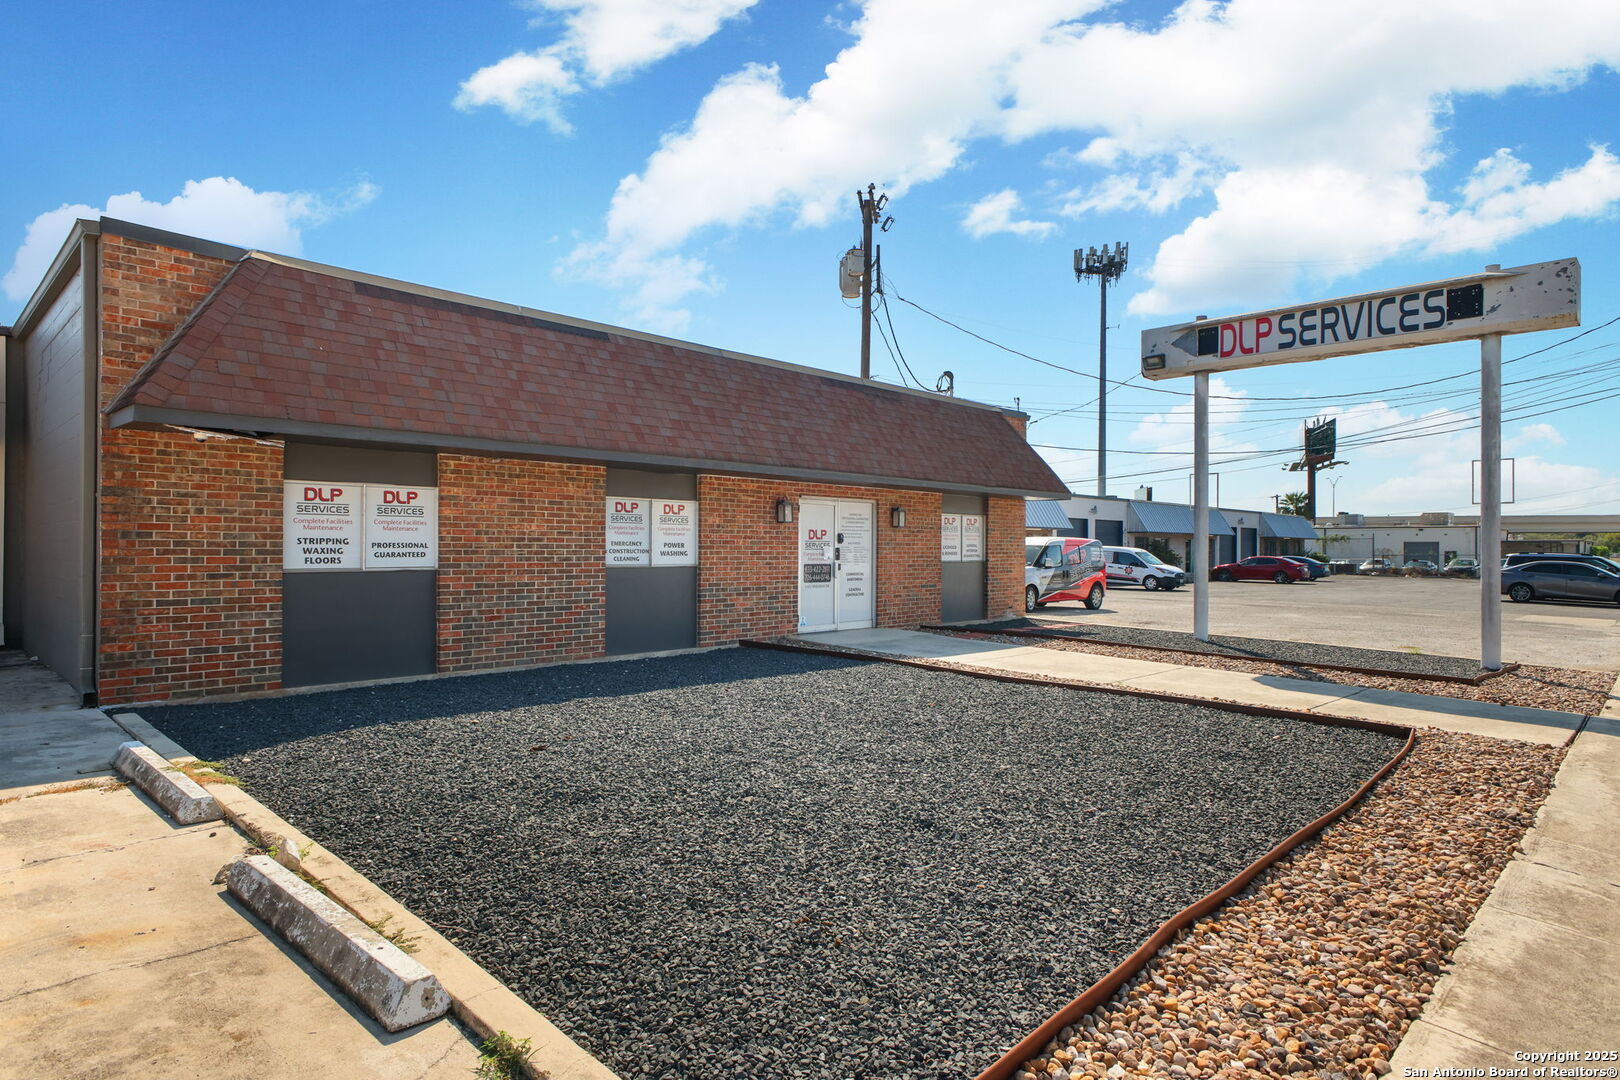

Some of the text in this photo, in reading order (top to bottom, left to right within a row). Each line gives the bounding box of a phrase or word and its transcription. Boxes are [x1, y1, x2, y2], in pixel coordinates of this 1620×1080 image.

[1220, 289, 1447, 358] DLP SERVICES
[304, 487, 343, 502] DLP
[383, 490, 418, 504] DLP
[296, 505, 350, 514] SERVICES
[377, 507, 424, 516] SERVICES
[615, 502, 639, 513] DLP
[663, 504, 685, 515] DLP
[293, 517, 353, 526] Complete Facilities
[373, 519, 402, 527] Complete
[944, 517, 956, 525] DLP
[966, 518, 978, 526] DLP
[808, 529, 827, 540] DLP
[302, 547, 344, 555] WAXING
[304, 556, 342, 565] FLOORS
